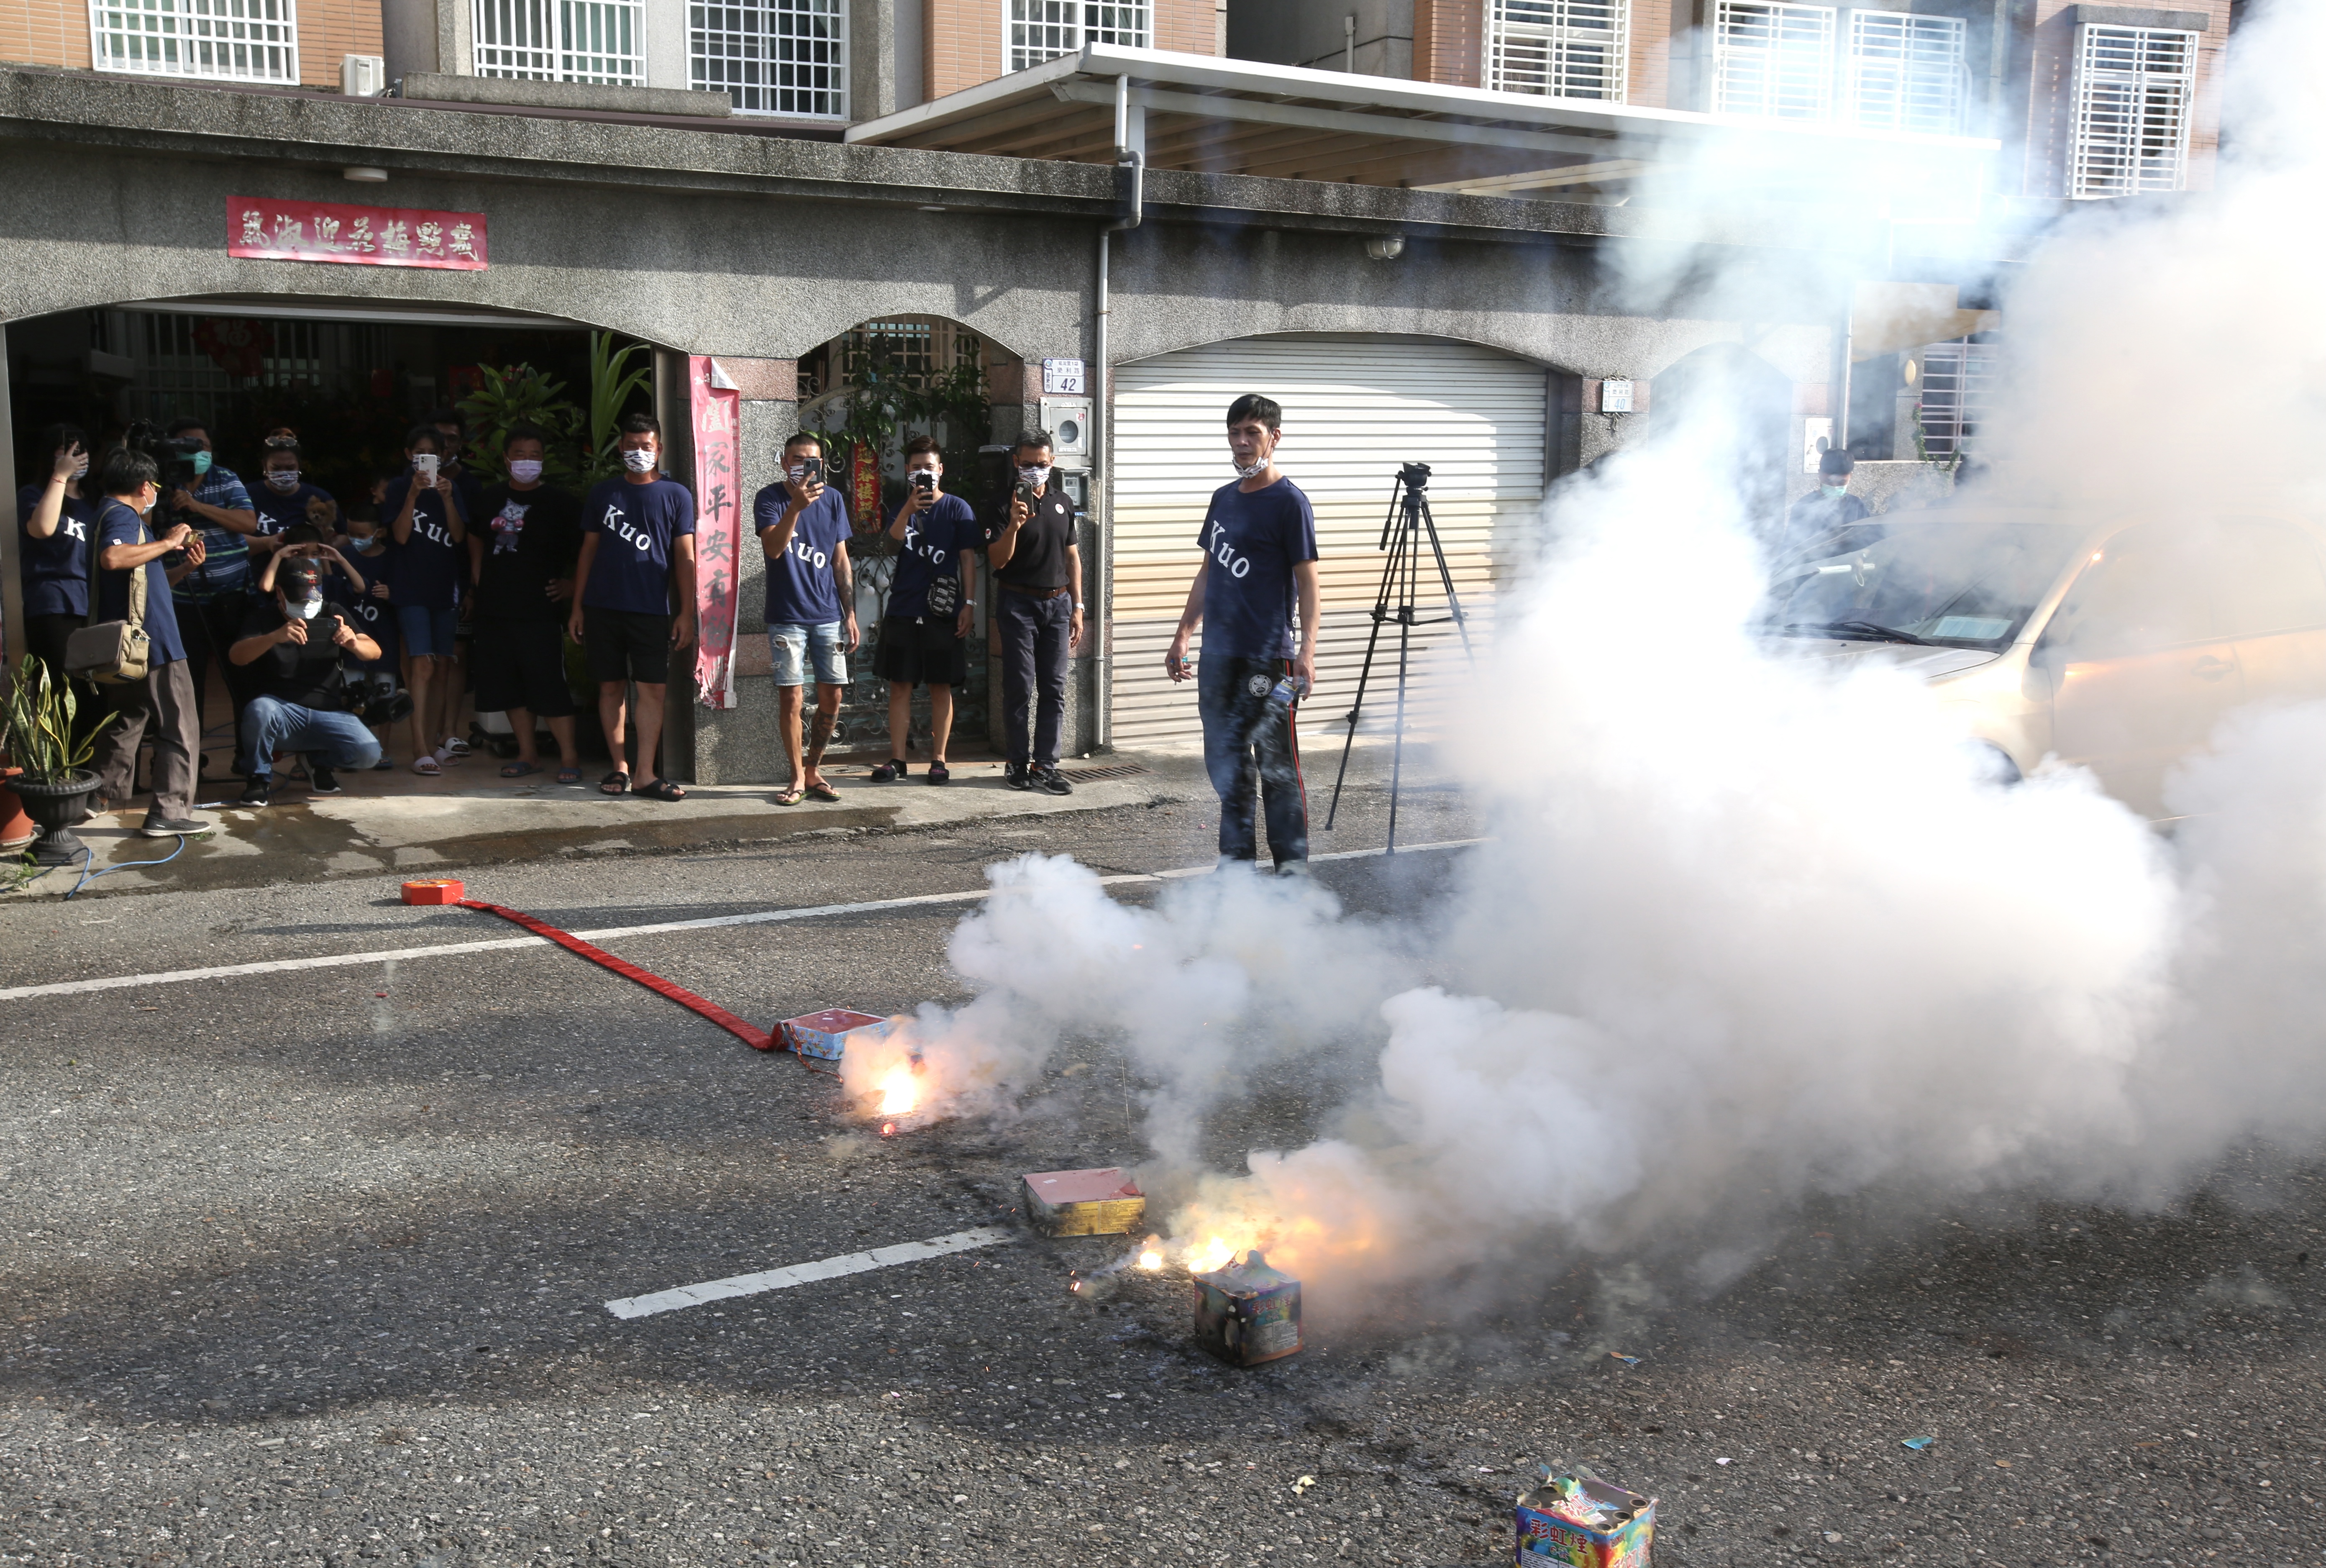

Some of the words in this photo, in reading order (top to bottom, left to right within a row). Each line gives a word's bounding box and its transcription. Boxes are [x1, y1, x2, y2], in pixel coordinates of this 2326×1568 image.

[1061, 378, 1076, 391] 42
[1614, 398, 1626, 409] 40
[603, 504, 651, 551] Kuo
[1210, 520, 1250, 578] Kuo
[1530, 1518, 1588, 1555] 彩虹煙
